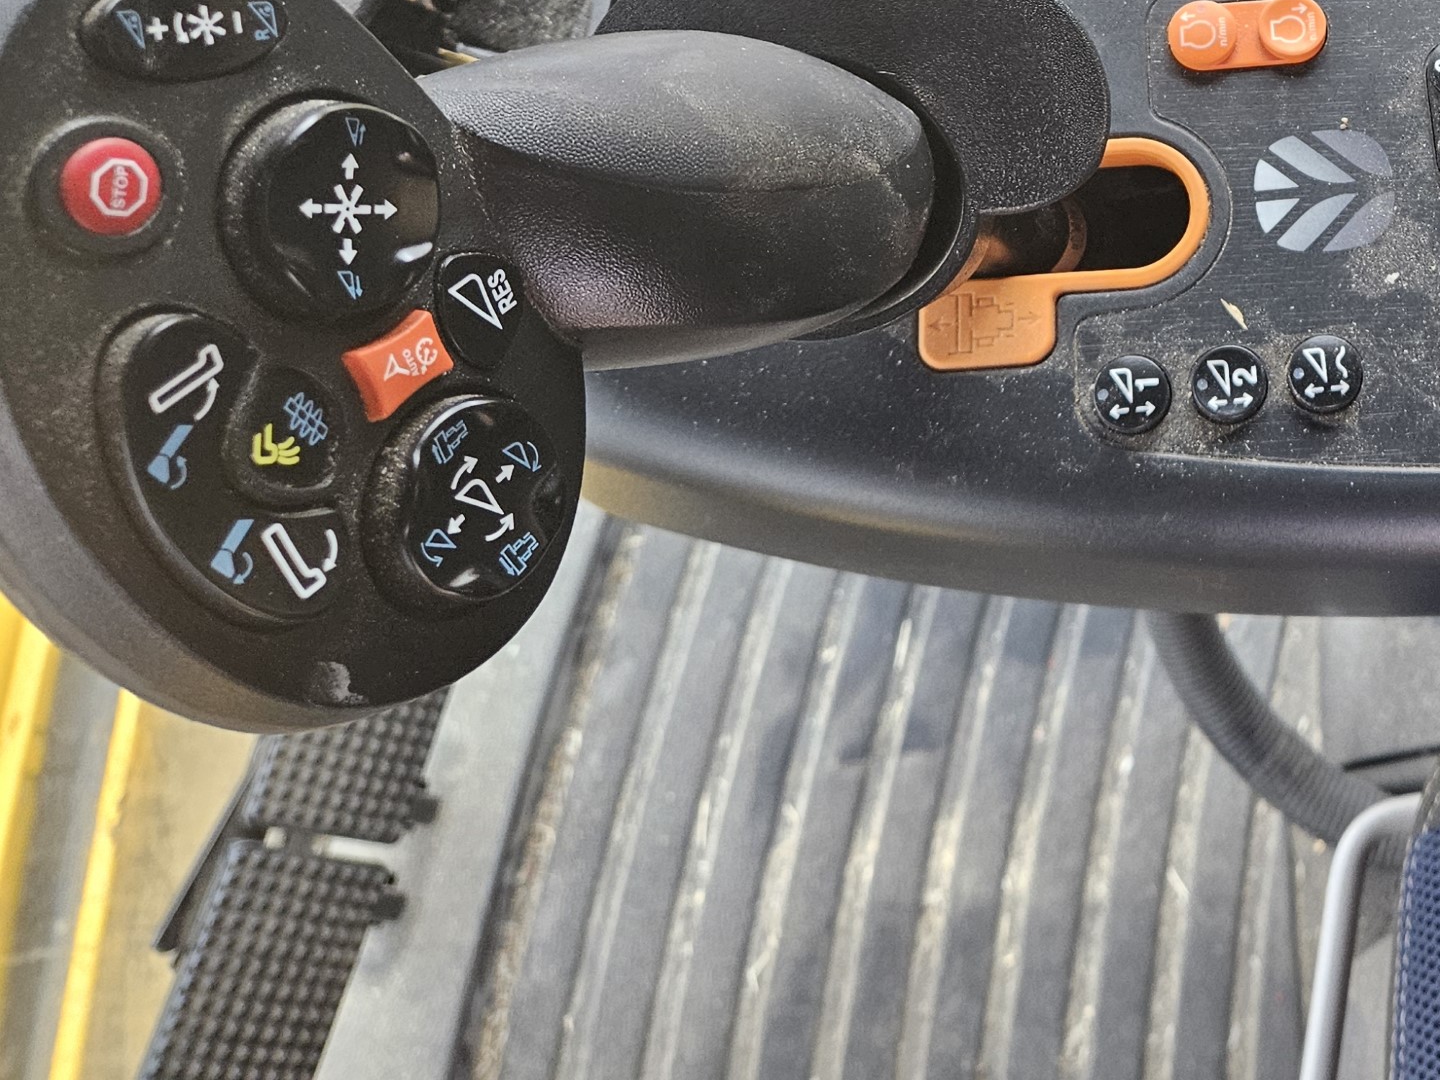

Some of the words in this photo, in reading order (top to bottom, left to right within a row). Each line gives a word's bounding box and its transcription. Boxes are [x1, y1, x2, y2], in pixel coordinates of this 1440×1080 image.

[254, 30, 272, 41] R
[1218, 16, 1228, 46] n/min
[1309, 11, 1317, 42] n/min
[110, 166, 131, 210] STOP
[487, 268, 518, 315] RES
[402, 349, 421, 377] AUTO
[1231, 365, 1258, 387] 2
[1134, 377, 1160, 392] 1
